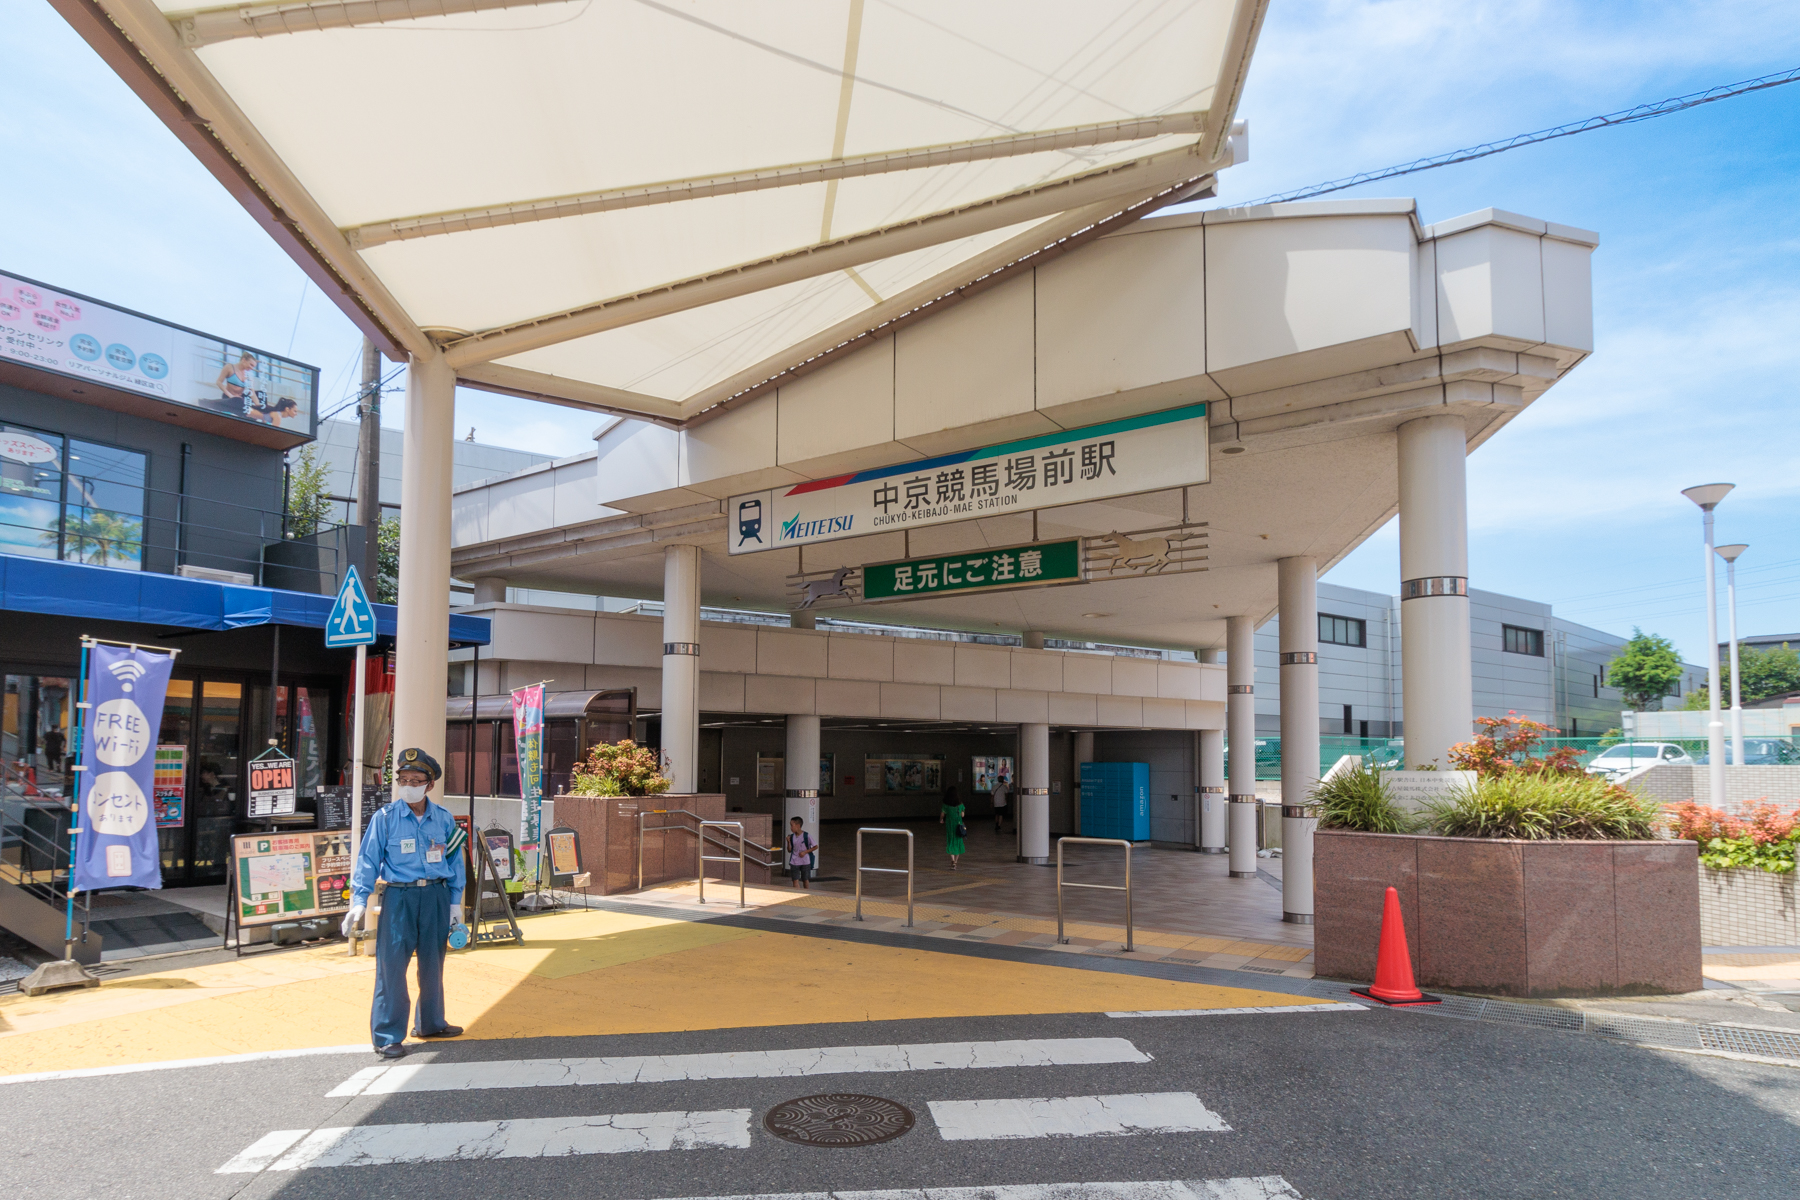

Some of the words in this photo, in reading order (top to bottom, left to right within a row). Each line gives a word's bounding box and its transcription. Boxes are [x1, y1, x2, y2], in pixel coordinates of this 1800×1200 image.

[0, 440, 52, 454] ッズスペース
[873, 440, 1117, 514] 中京競馬場前駅
[977, 494, 1018, 510] STATION
[779, 511, 854, 541] MEITETSU
[893, 550, 1043, 592] 足元にご注意
[97, 711, 141, 733] FREE
[96, 735, 139, 756] Wi-Fi
[252, 768, 292, 790] OPEN
[99, 813, 134, 823] あります
[260, 842, 268, 851] P
